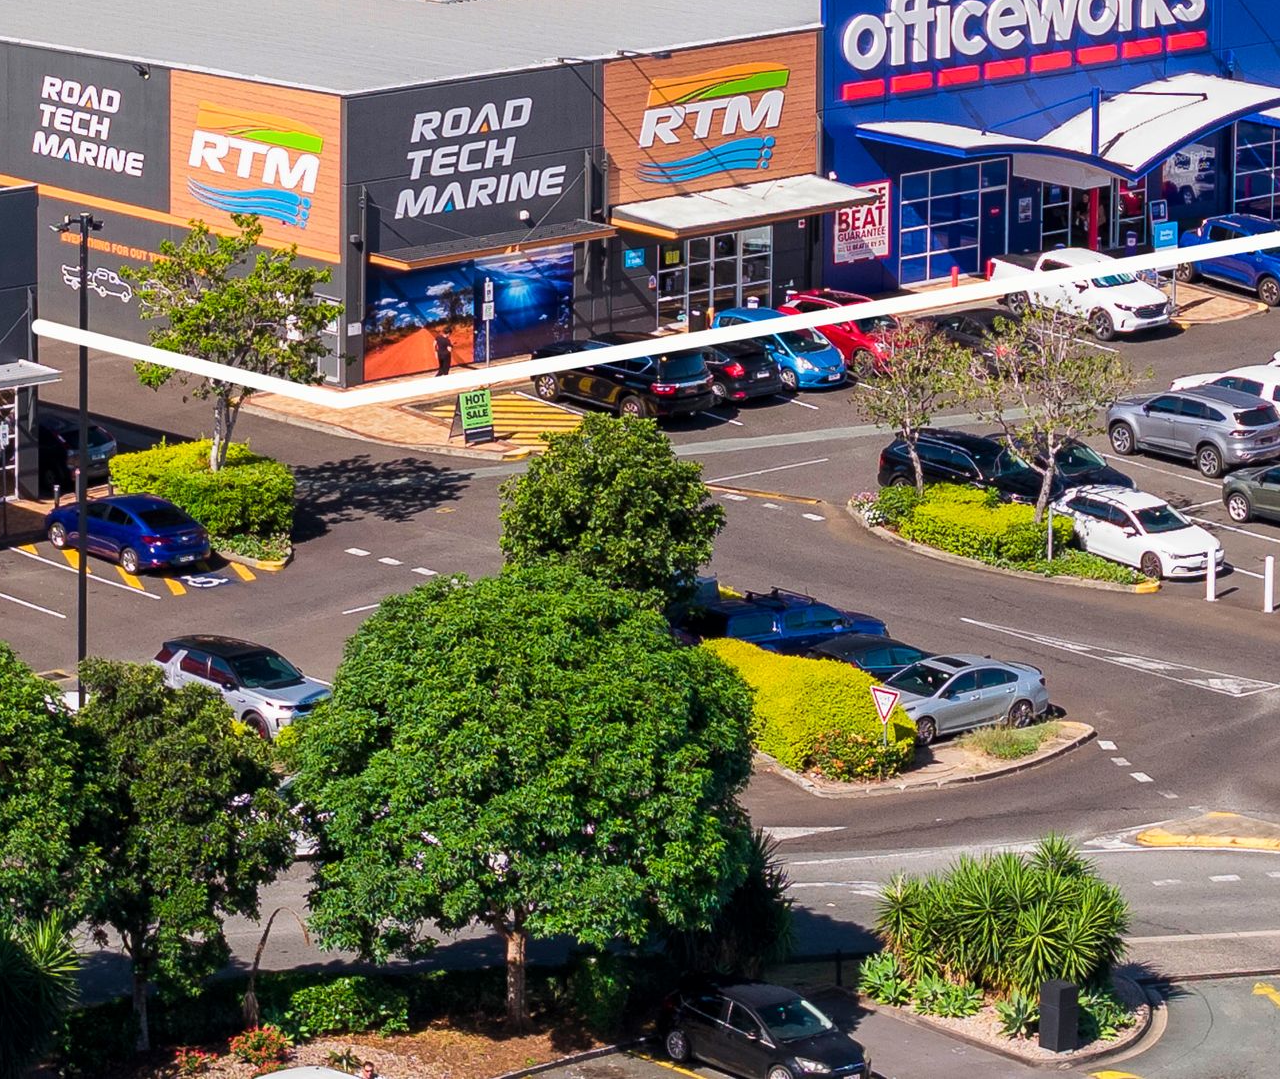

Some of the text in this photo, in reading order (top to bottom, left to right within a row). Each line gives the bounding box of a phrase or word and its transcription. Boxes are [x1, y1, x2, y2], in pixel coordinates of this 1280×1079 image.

[41, 75, 121, 114] ROAD
[39, 102, 111, 141] TECH
[410, 97, 533, 144] ROAD
[638, 89, 785, 148] RTM
[32, 130, 145, 177] MARINE
[188, 129, 320, 194] RTM
[406, 135, 517, 181] TECH
[394, 165, 567, 220] MARINE
[837, 204, 886, 233] BEAT
[837, 226, 886, 243] GUARANTEE
[464, 393, 486, 406] HOT
[465, 408, 489, 420] SALE
